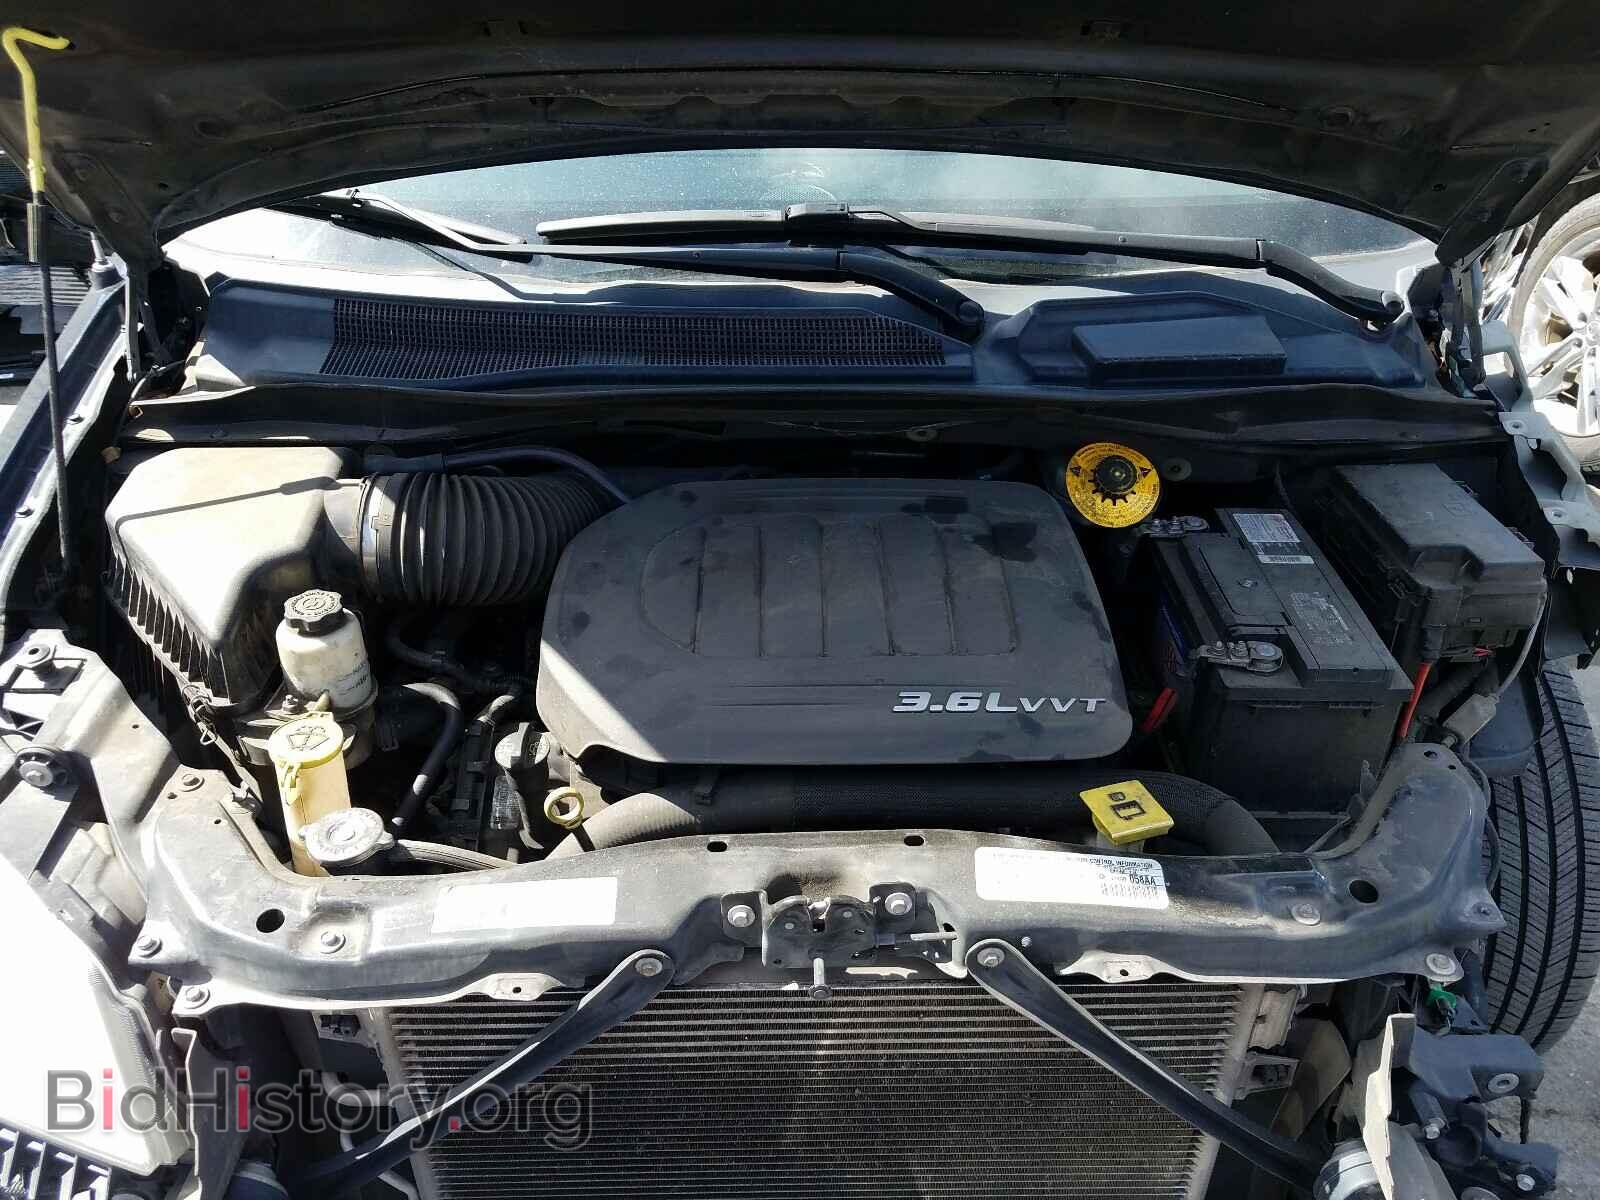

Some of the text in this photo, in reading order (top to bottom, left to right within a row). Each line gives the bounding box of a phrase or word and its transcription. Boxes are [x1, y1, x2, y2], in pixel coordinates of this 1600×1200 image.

[892, 691, 1107, 714] 3.6L VVT
[1115, 860, 1154, 869] INFORMATION
